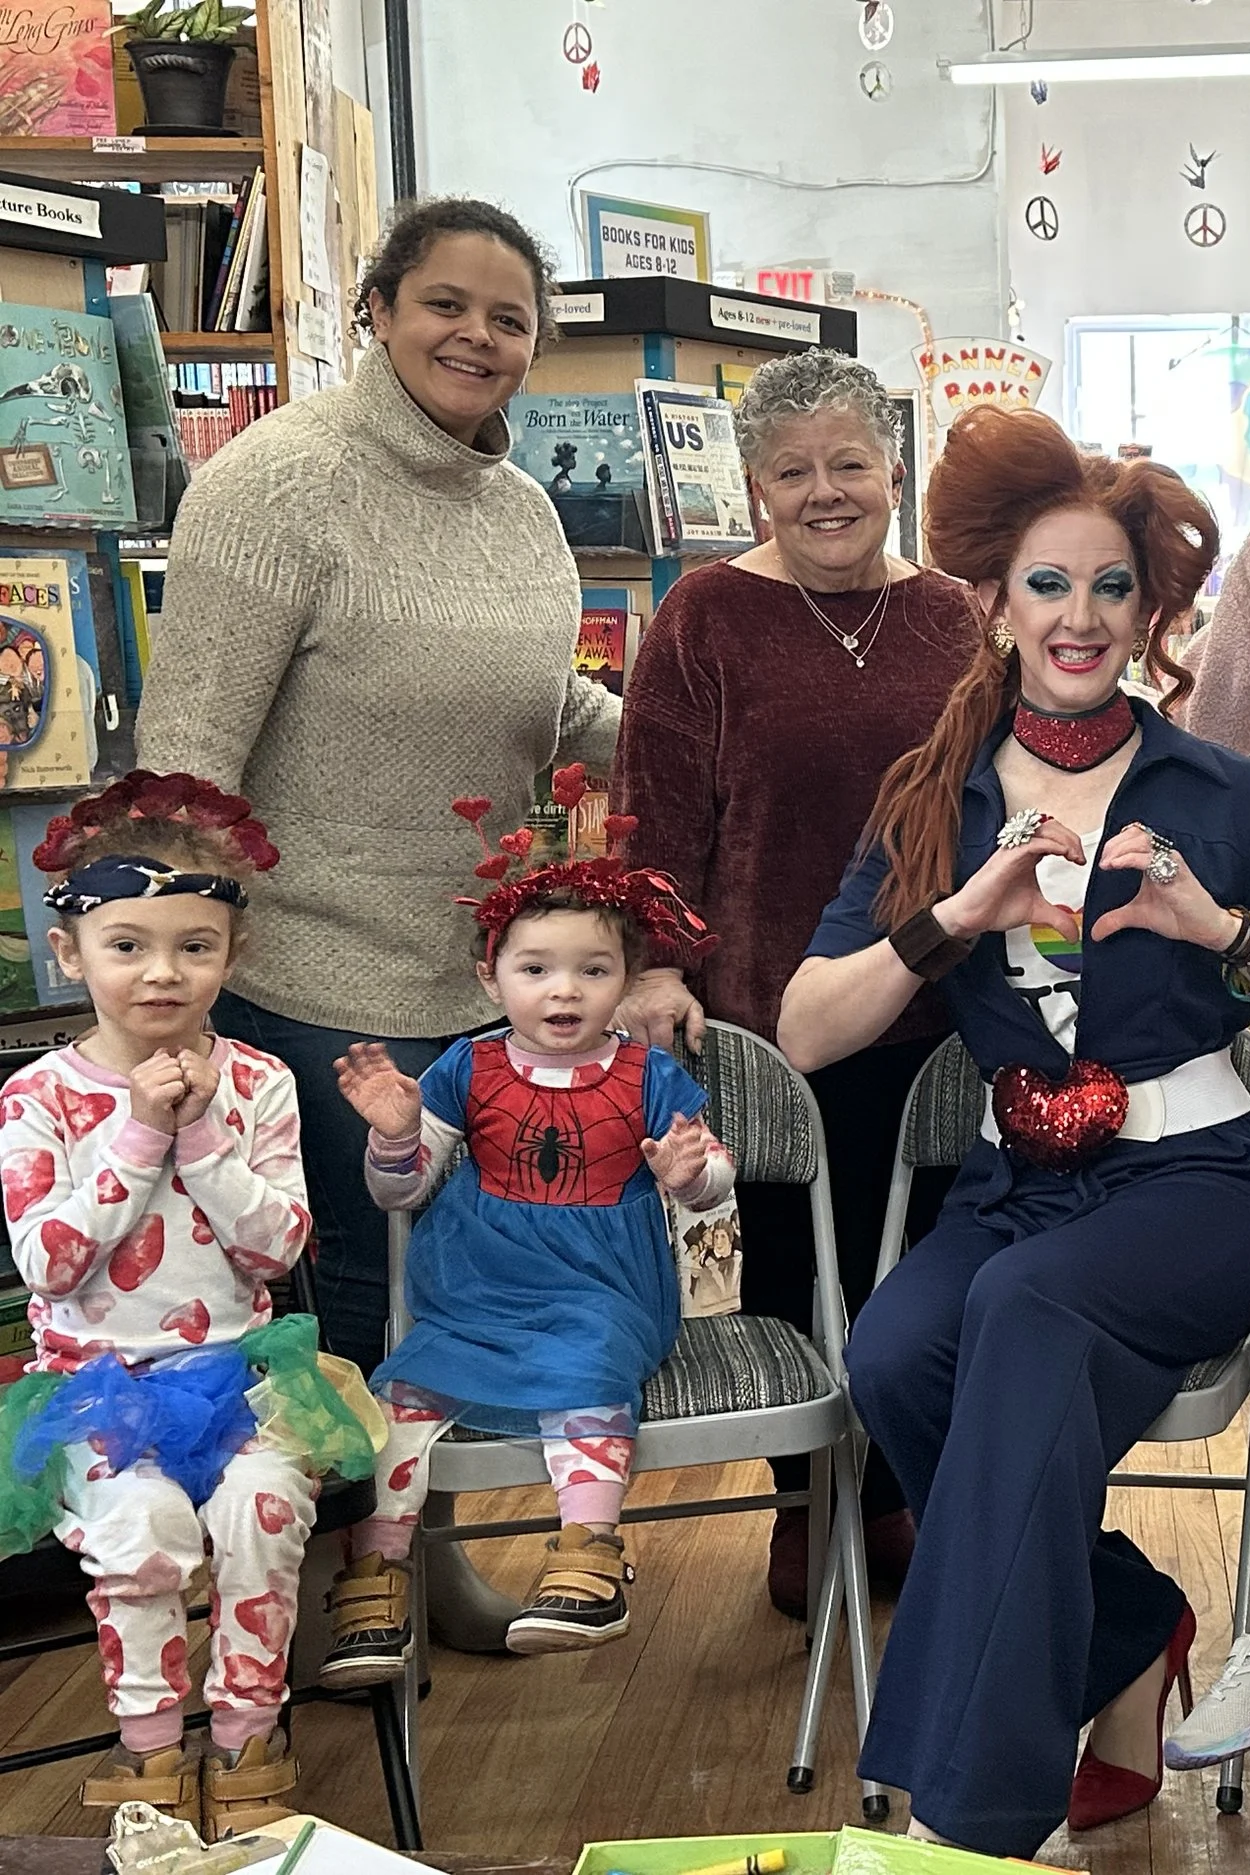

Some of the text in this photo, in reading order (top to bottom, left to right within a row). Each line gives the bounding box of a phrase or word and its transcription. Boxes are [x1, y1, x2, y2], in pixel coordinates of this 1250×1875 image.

[0, 9, 42, 54] Long
[0, 198, 82, 224] ture Books
[602, 225, 695, 256] BOOKS FOR KIDS
[625, 253, 677, 275] AGES 8-12
[551, 302, 591, 314] re-loved
[718, 307, 736, 321] Ages
[737, 310, 755, 323] 8-12
[778, 320, 812, 333] pre-loved
[919, 347, 1042, 381] BANNED
[944, 380, 1030, 408] BOOKS
[525, 409, 567, 428] Born
[584, 409, 631, 428] Water
[666, 421, 704, 451] US
[0, 584, 60, 606] FACES
[596, 633, 612, 646] WE
[584, 648, 616, 660] AWAY
